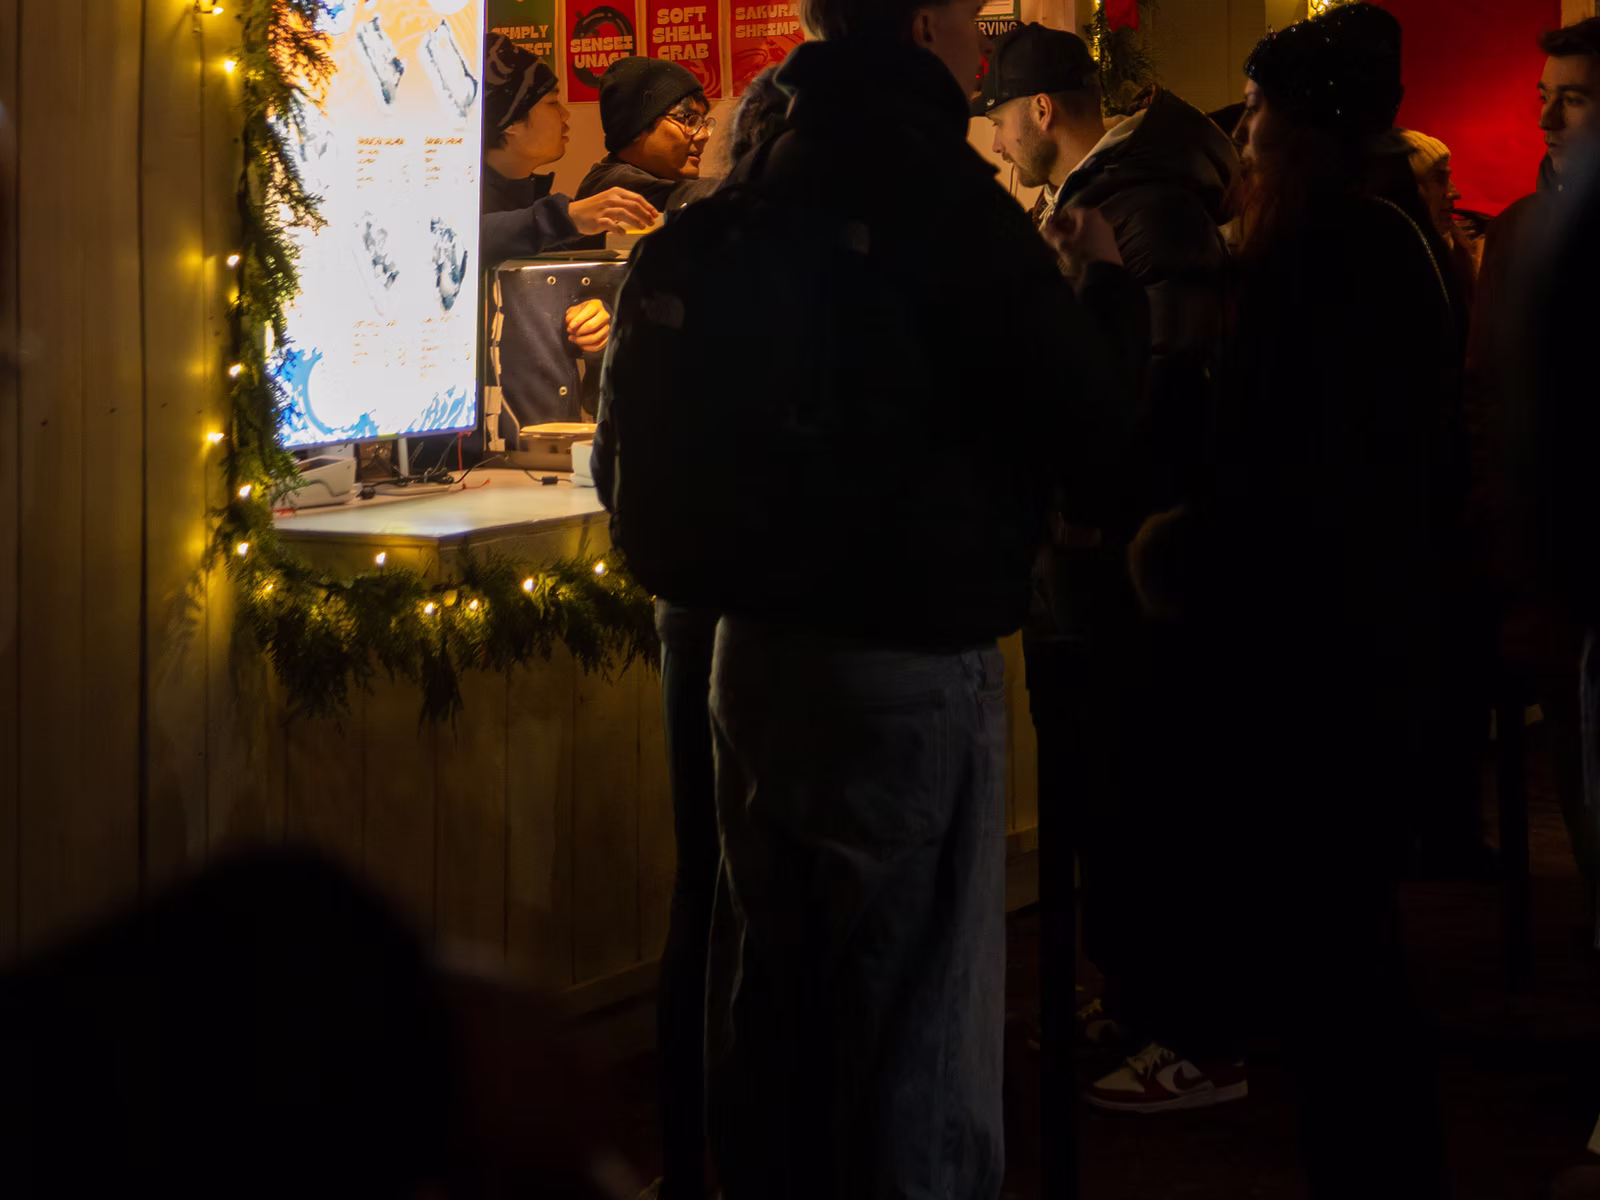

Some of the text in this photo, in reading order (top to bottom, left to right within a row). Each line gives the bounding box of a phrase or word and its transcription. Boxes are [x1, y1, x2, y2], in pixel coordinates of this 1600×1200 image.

[657, 6, 707, 25] SOFT
[735, 4, 799, 21] SAKURA
[652, 24, 713, 44] SHELL
[735, 21, 800, 39] SHRIMP
[974, 20, 1018, 36] RVING
[570, 35, 633, 53] SENSEI
[657, 43, 709, 61] CRAB
